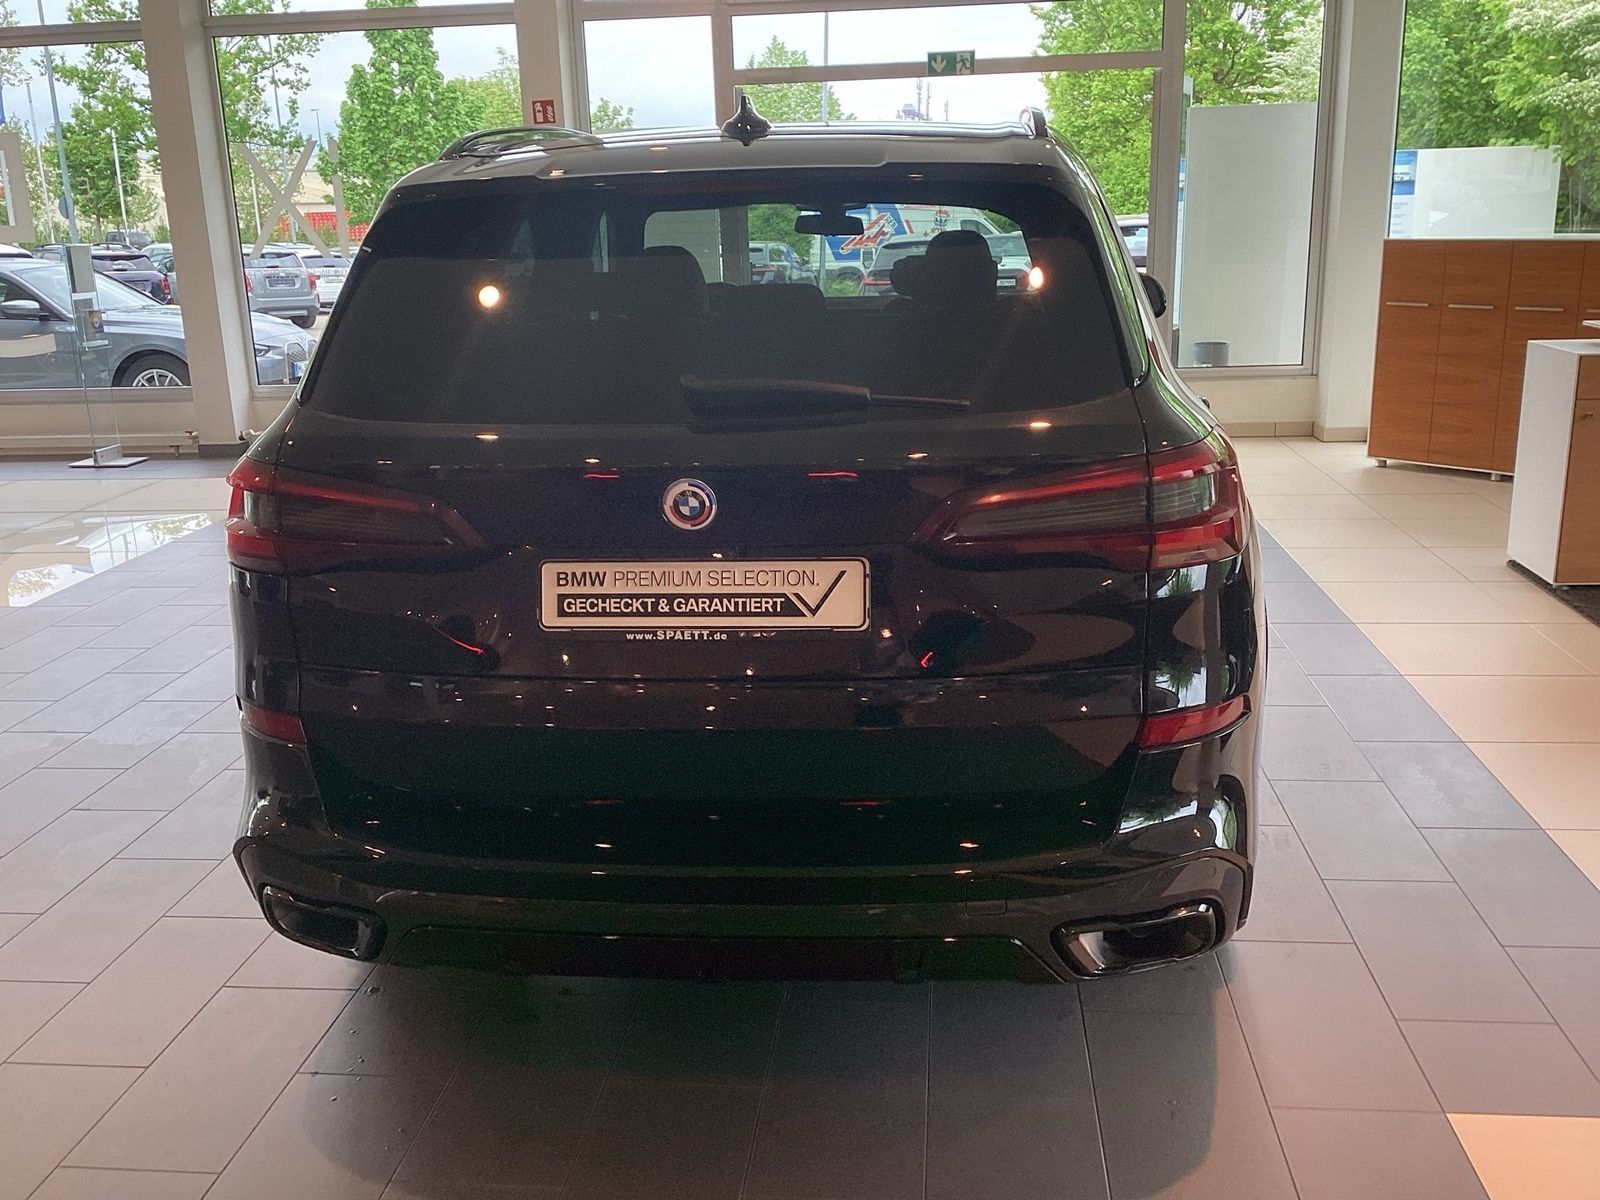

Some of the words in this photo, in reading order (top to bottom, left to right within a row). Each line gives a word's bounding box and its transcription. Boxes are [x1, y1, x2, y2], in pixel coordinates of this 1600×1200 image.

[556, 571, 607, 587] BMW
[614, 570, 702, 587] PREMIUM
[707, 569, 820, 587] SELECTION.
[563, 598, 655, 613] GECHECKT
[657, 598, 670, 613] &
[673, 597, 785, 613] GARANTIERT
[626, 630, 728, 641] www.SPAETT.de
